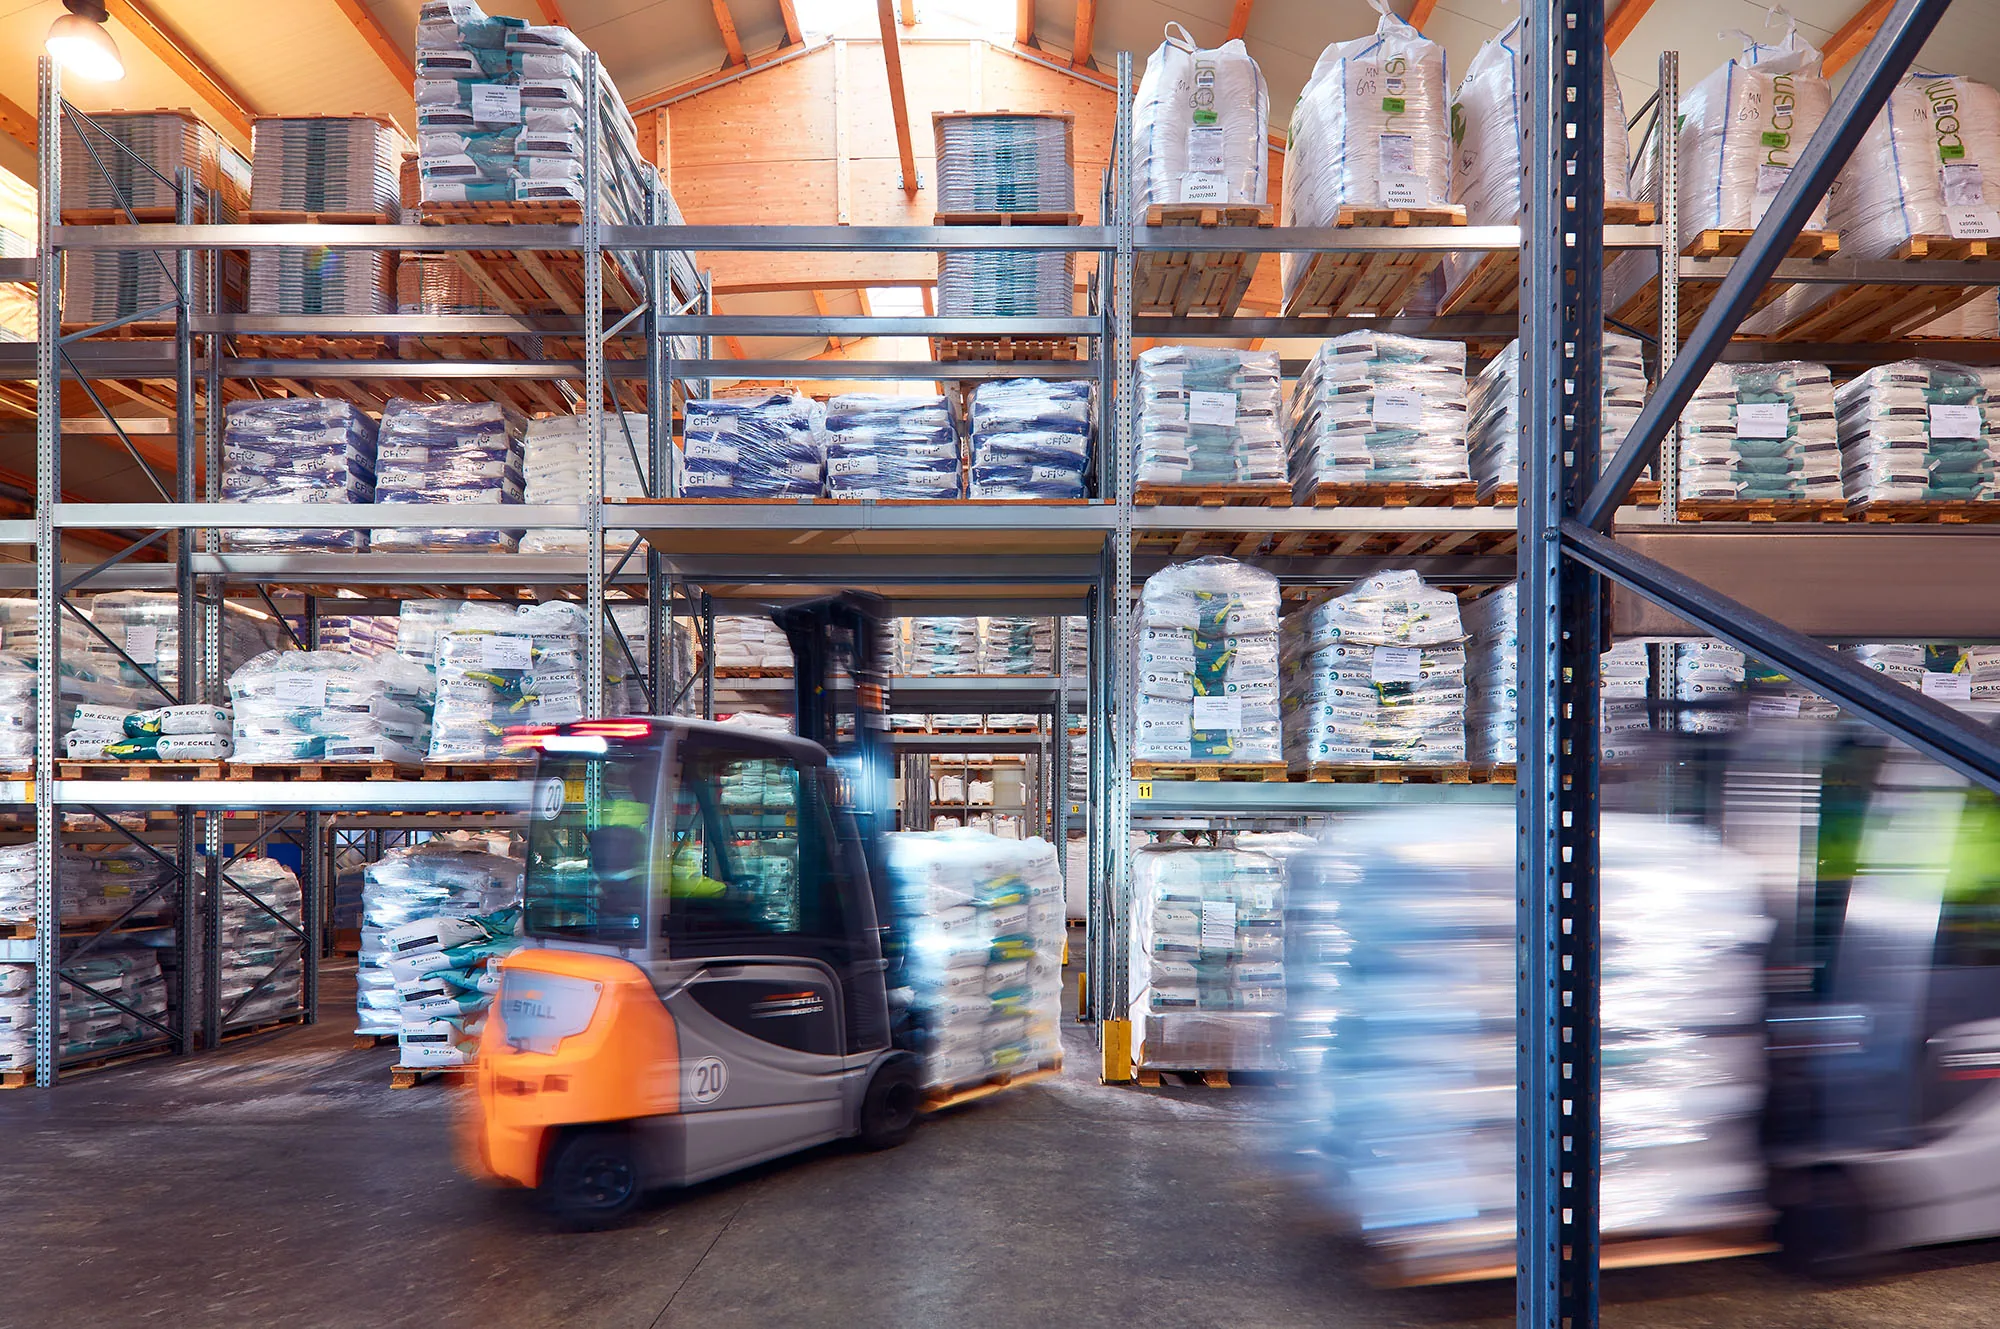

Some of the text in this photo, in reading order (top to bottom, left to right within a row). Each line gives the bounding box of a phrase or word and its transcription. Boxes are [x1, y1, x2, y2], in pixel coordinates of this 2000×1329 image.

[464, 681, 487, 689] ECKEL
[546, 782, 562, 812] 20
[1139, 786, 1151, 797] 11
[792, 996, 823, 1006] STILL
[511, 999, 555, 1019] STILL
[697, 1062, 722, 1098] 20
